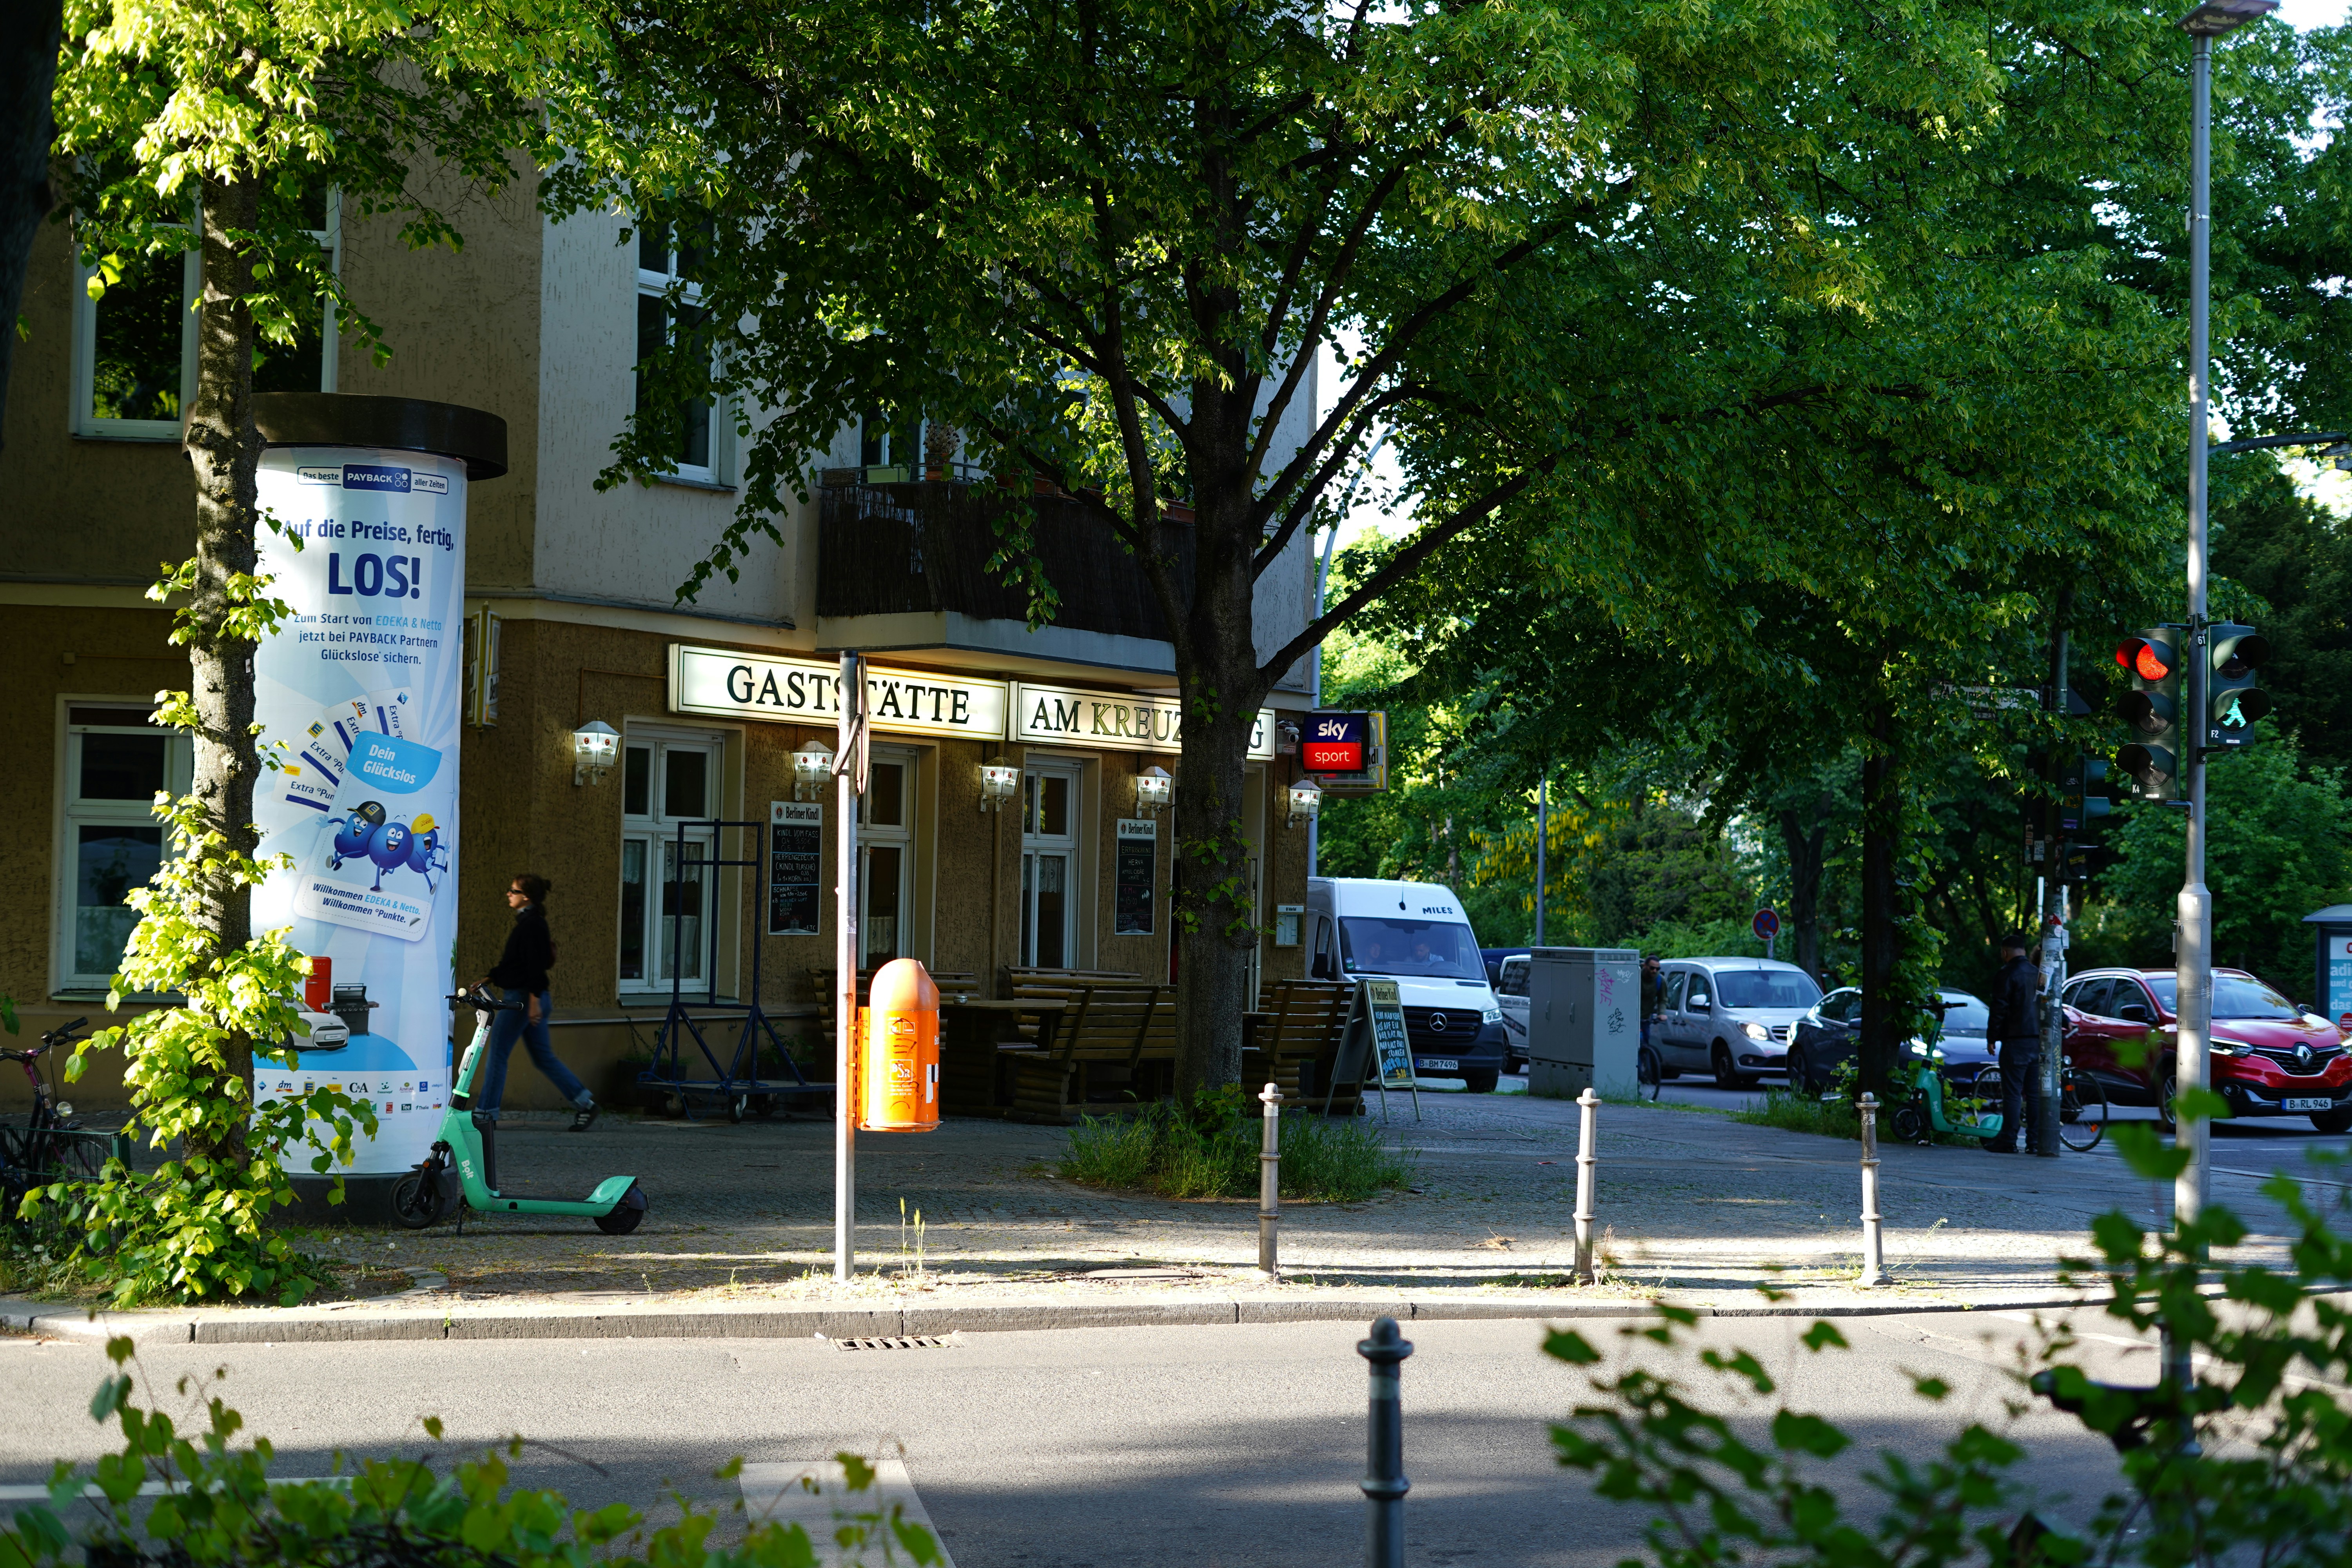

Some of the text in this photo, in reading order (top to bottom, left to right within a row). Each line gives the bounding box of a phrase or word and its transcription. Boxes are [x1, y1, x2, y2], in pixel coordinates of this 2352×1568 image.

[347, 473, 392, 483] PAYBACK
[415, 478, 428, 487] aller
[429, 480, 445, 489] Zeiten
[318, 519, 345, 538] die
[352, 521, 411, 544] Preise,
[417, 524, 454, 551] fertig,
[329, 553, 420, 599] LOS!
[294, 613, 442, 631] Zum Start von EDEKA & Netto
[299, 630, 437, 648] jetzt bei PAYBACK Partnern
[2198, 635, 2206, 645] 61
[383, 652, 421, 664] sichern.
[357, 702, 367, 715] dm
[1030, 697, 1081, 733] AM
[389, 705, 399, 729] Extra
[1318, 719, 1348, 740] sky
[2211, 730, 2219, 738] F2
[310, 741, 331, 761] Extra
[369, 744, 396, 761] Dein
[1315, 750, 1350, 764] sport
[363, 760, 416, 784] Glückslos
[290, 781, 314, 794] Extra
[2132, 784, 2140, 793] K4
[786, 806, 819, 820] Berliner Kindl
[420, 818, 432, 827] Netto
[1129, 823, 1154, 835] Berliner Kindl
[313, 883, 363, 901] Willkommen
[365, 894, 391, 907] EDEKA
[399, 902, 421, 915] Netto.
[322, 897, 372, 915] Willkommen
[2330, 979, 2346, 987] und
[1375, 987, 1397, 1000] Berliner Kindl
[2330, 998, 2351, 1010] das
[1384, 1011, 1393, 1020] MAN
[1387, 1030, 1396, 1039] HAT
[1379, 1041, 1388, 1050] MAN
[1388, 1048, 1405, 1057] TRINKEN
[892, 1063, 911, 1078] BSR
[278, 1080, 292, 1089] dm
[349, 1082, 369, 1093] C&A
[2290, 1099, 2328, 1109] B RL 946
[461, 1159, 474, 1180] Bolt
